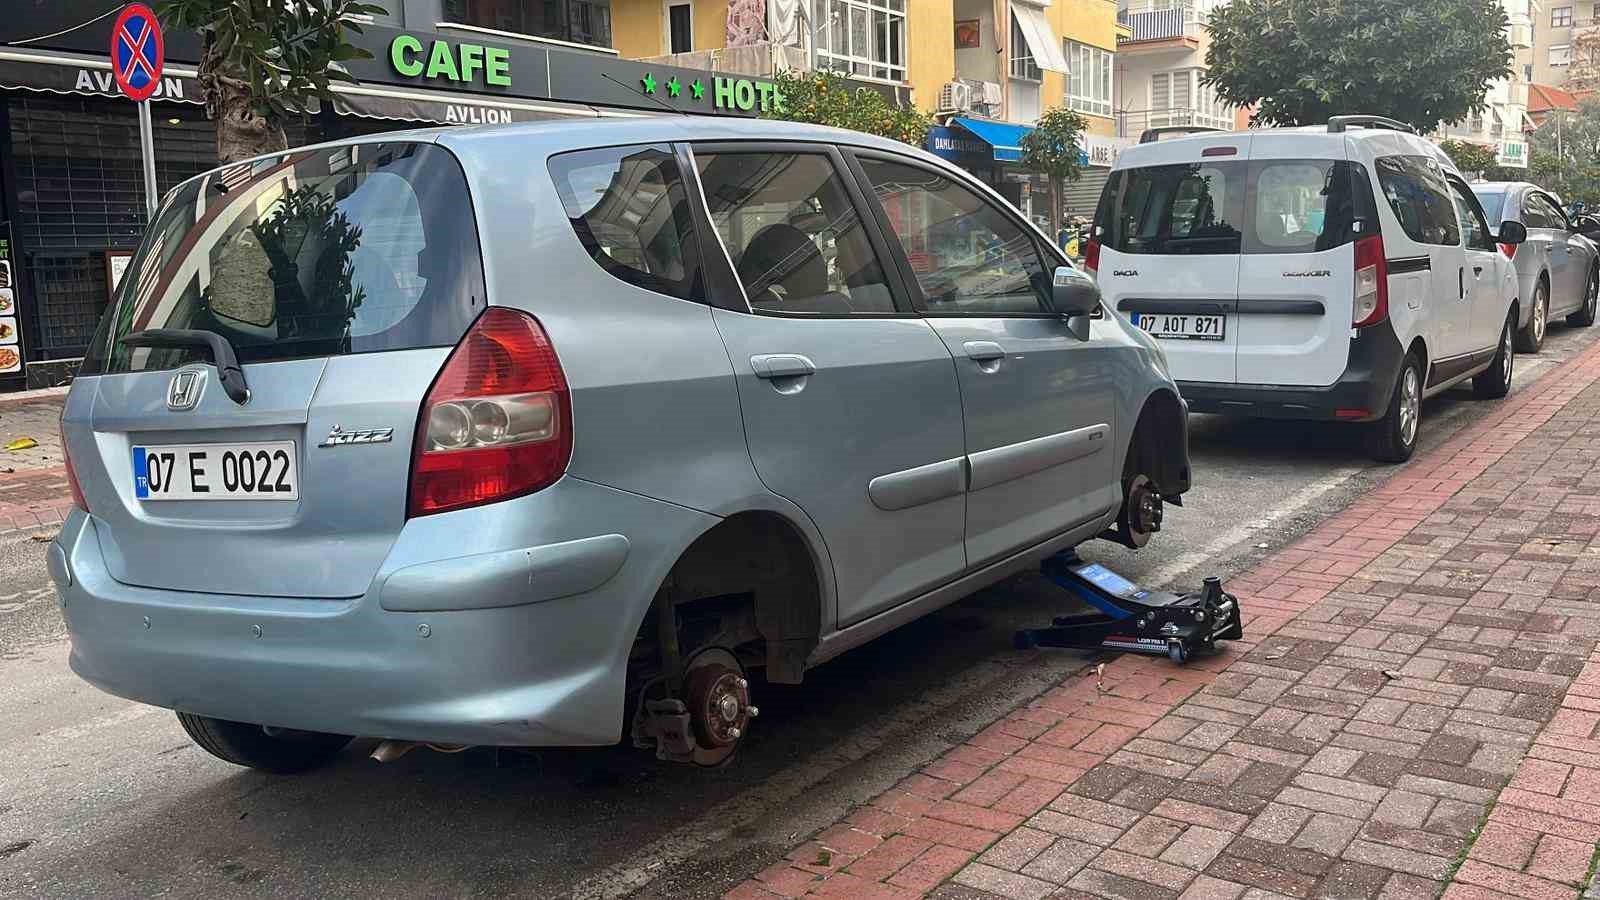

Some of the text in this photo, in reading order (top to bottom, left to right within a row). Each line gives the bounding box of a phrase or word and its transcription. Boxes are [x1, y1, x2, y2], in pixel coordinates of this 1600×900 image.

[390, 35, 512, 86] CAFE
[75, 69, 184, 98] AVN
[444, 104, 512, 124] AVLION
[1140, 316, 1219, 334] 07 AOT 871
[318, 423, 394, 448] jazz
[137, 477, 148, 488] TR
[147, 450, 292, 493] 07 E 0022
